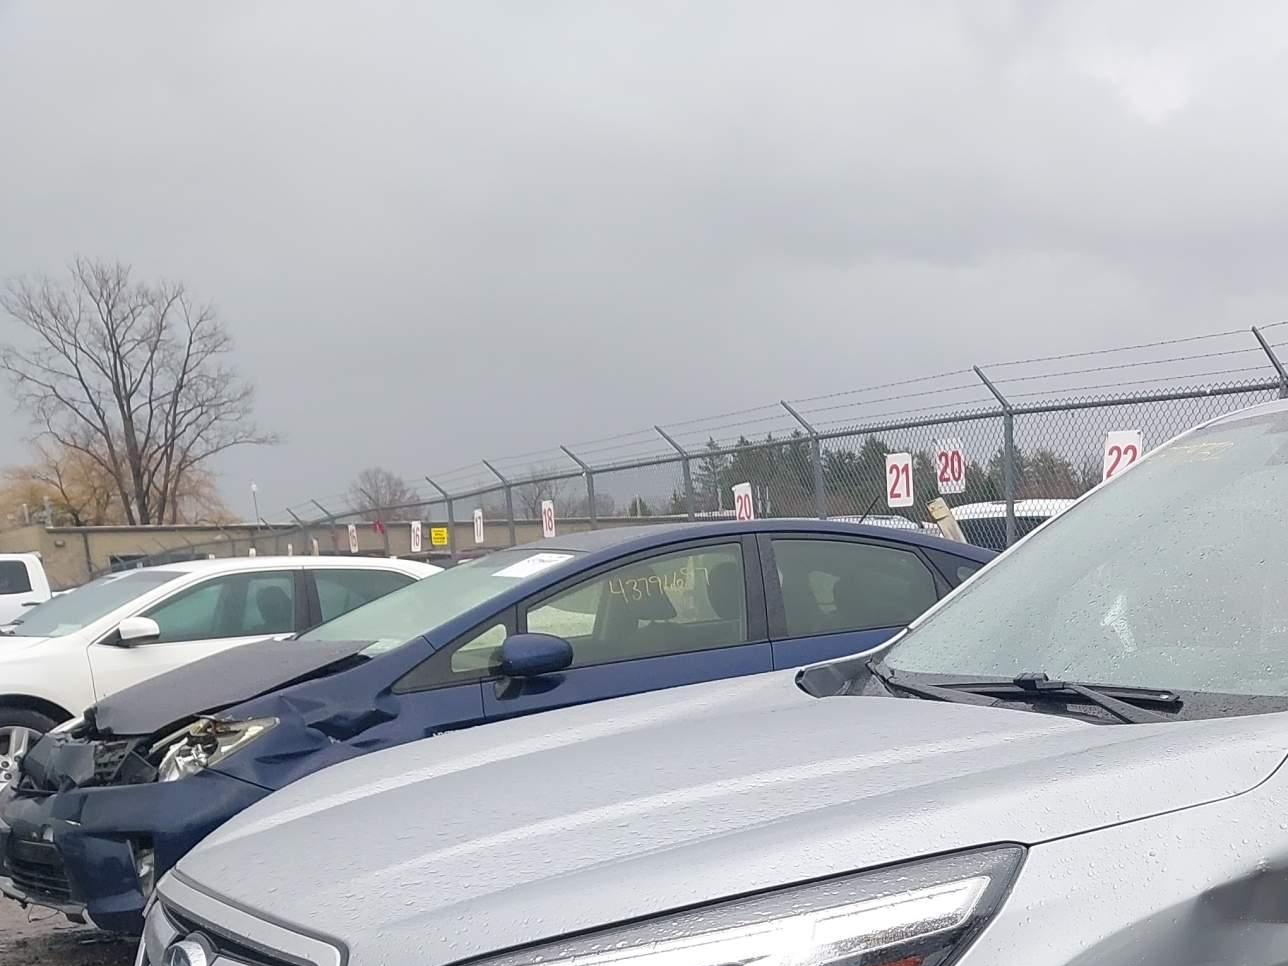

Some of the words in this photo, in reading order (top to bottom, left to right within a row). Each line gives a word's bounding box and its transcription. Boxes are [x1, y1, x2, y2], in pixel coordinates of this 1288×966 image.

[938, 450, 962, 483] 20
[888, 463, 911, 499] 21
[736, 494, 752, 520] 20
[475, 516, 482, 538] 17
[543, 508, 554, 533] 18
[412, 528, 420, 547] 16
